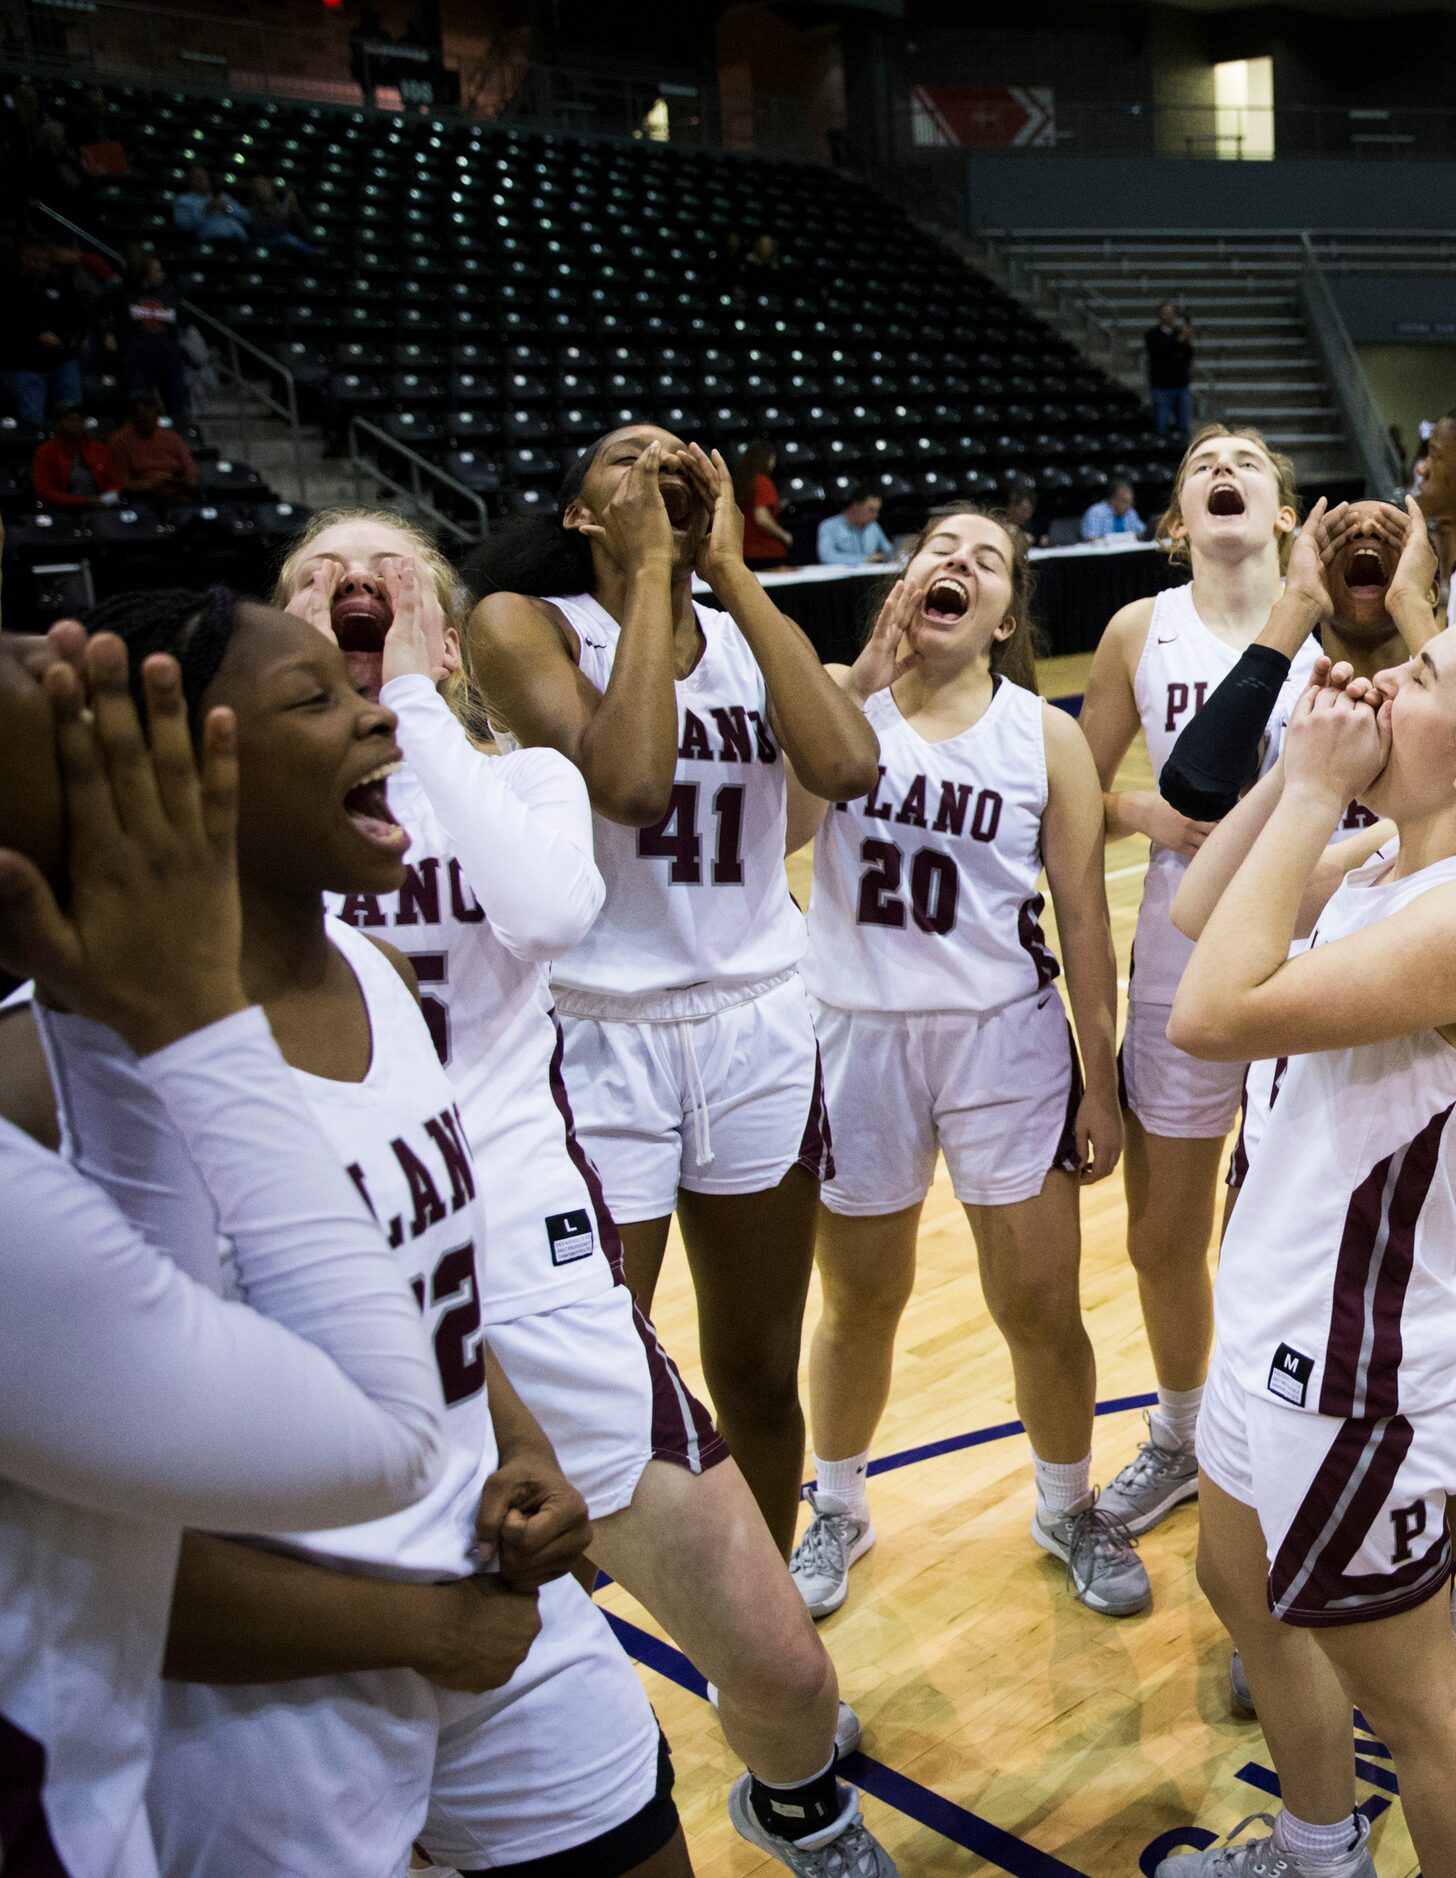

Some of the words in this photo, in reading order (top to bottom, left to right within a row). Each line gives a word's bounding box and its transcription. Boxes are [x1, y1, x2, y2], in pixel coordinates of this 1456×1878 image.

[635, 780, 747, 887] 41
[835, 765, 1003, 843] LANO
[856, 836, 960, 937] 20
[563, 1218, 578, 1233] L
[410, 1238, 487, 1409] 2
[1283, 1352, 1300, 1374] M
[1390, 1499, 1427, 1565] P
